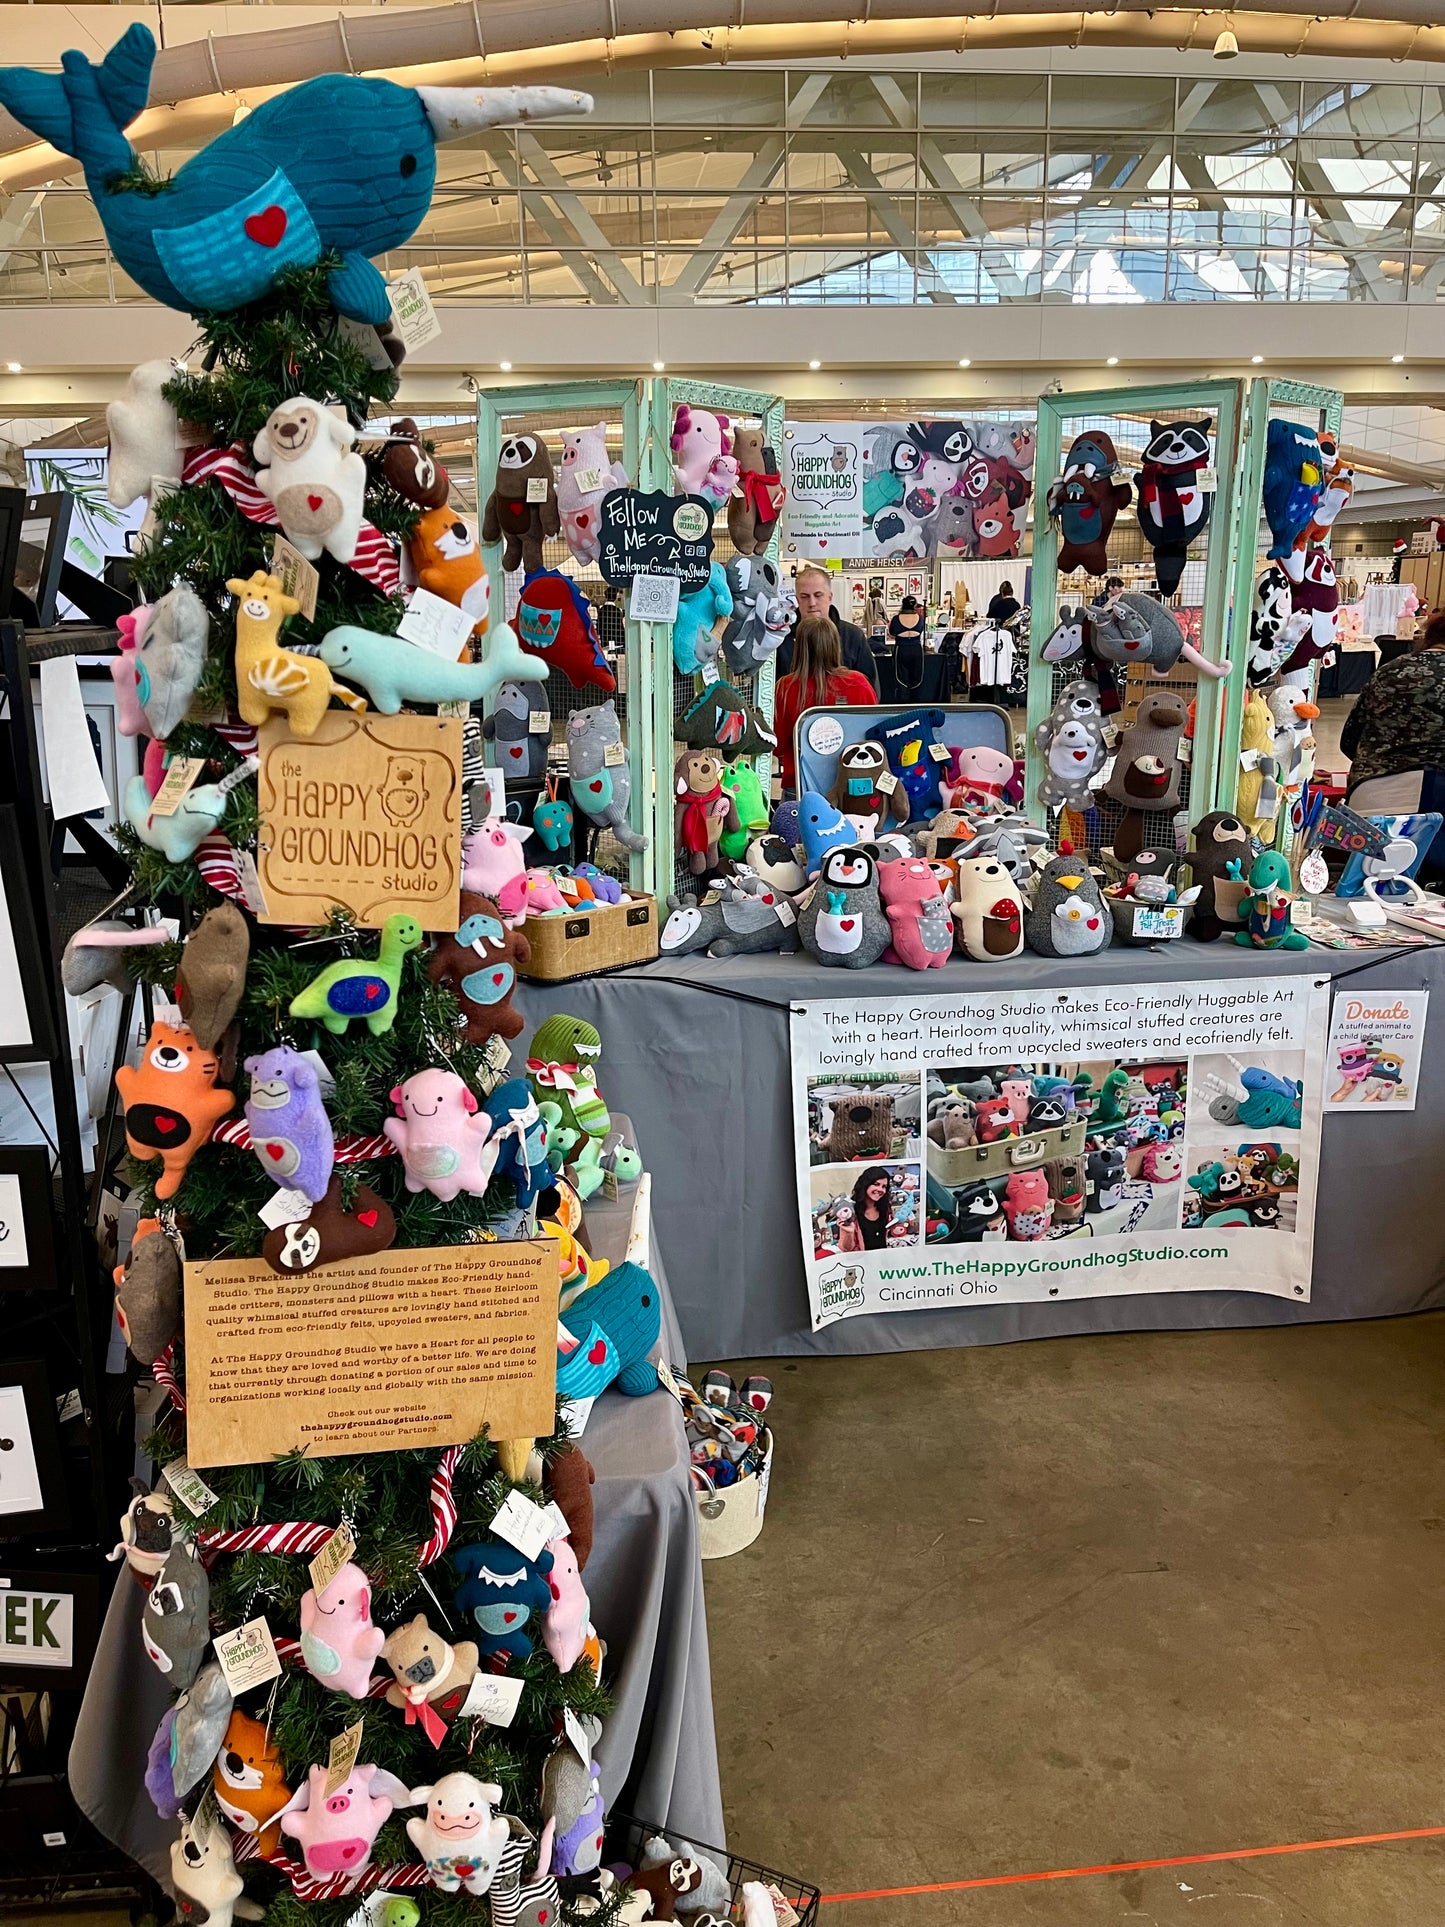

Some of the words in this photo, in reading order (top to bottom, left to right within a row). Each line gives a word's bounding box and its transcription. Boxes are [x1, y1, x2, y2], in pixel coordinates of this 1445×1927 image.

[606, 496, 660, 527] Follow
[849, 558, 875, 567] ANNIE
[878, 558, 906, 567] HEISEY
[281, 760, 301, 776] the
[1316, 818, 1366, 850] HELLO
[822, 1012, 849, 1025] The
[856, 1011, 904, 1025] Happy
[909, 1006, 994, 1021] Groundhog
[1000, 1004, 1046, 1016] Studio
[1051, 1002, 1098, 1014] makes
[1104, 994, 1192, 1011] Eco-Friendly
[1198, 990, 1268, 1006] Huggable
[1274, 990, 1293, 1001] Art
[1347, 1001, 1409, 1020] Donate
[832, 1030, 860, 1044] with
[882, 1028, 923, 1041] heart.
[930, 1024, 996, 1038] Heirloom
[1002, 1022, 1055, 1037] quality,
[1061, 1017, 1132, 1032] whimsical
[1138, 1014, 1184, 1028] stuffed
[1190, 1012, 1254, 1026] creatures
[1260, 1011, 1282, 1022] are
[819, 1051, 875, 1066] lovingly
[880, 1046, 917, 1061] hand
[923, 1044, 972, 1058] crafted
[978, 1042, 1011, 1055] from
[1018, 1038, 1080, 1056] upcycled
[1086, 1037, 1148, 1050] sweaters
[1153, 1034, 1180, 1047] and
[1186, 1028, 1262, 1045] ecofriendly
[1268, 1026, 1294, 1040] felt.
[205, 1277, 245, 1286] Melissa
[326, 1269, 355, 1278] artist
[358, 1268, 376, 1276] and
[380, 1266, 418, 1275] founder
[455, 1262, 486, 1270] Happy
[489, 1258, 542, 1268] Groundhog
[879, 1246, 1229, 1280] www.TheHappyGroundhogStudio.com
[208, 1304, 236, 1312] made
[240, 1300, 283, 1310] critters,
[286, 1298, 334, 1306] monsters
[337, 1296, 356, 1304] and
[358, 1294, 394, 1304] pillows
[398, 1290, 419, 1300] with
[463, 1286, 492, 1295] These
[494, 1282, 538, 1292] Heirloom
[254, 1287, 274, 1296] The
[277, 1286, 310, 1296] Happy
[313, 1282, 369, 1292] Groundhog
[372, 1280, 404, 1288] Studio
[407, 1277, 438, 1286] makes
[442, 1272, 504, 1284] Eco-Friendly
[879, 1284, 954, 1301] Cincinnati
[960, 1282, 998, 1296] Ohio
[206, 1316, 243, 1326] quality
[247, 1312, 298, 1322] whimsical
[302, 1309, 337, 1318] stuffed
[341, 1306, 388, 1316] creatures
[412, 1302, 450, 1312] lovingly
[454, 1299, 478, 1308] hand
[480, 1296, 520, 1306] stitched
[522, 1294, 540, 1303] and
[217, 1328, 254, 1338] crafted
[258, 1326, 282, 1335] from
[286, 1322, 347, 1332] eco-friendly
[378, 1317, 422, 1328] upcycled
[424, 1314, 471, 1323] sweaters,
[474, 1310, 492, 1319] and
[494, 1308, 530, 1318] fabrics.
[210, 1368, 238, 1377] know
[241, 1366, 262, 1375] that
[266, 1364, 288, 1374] they
[292, 1364, 308, 1372] are
[312, 1361, 338, 1370] loved
[342, 1359, 360, 1367] and
[363, 1356, 398, 1366] worthy
[422, 1352, 452, 1361] better
[492, 1348, 507, 1356] are
[510, 1346, 536, 1356] doing
[226, 1355, 246, 1363] The
[249, 1352, 282, 1362] Happy
[286, 1348, 342, 1358] Groundhog
[344, 1346, 376, 1354] Studio
[396, 1342, 418, 1350] have
[430, 1339, 458, 1348] Heart
[461, 1338, 474, 1346] for
[492, 1335, 522, 1344] people
[209, 1382, 231, 1390] that
[234, 1378, 284, 1388] currently
[286, 1374, 326, 1385] through
[330, 1370, 374, 1381] donating
[386, 1368, 422, 1378] portion
[456, 1363, 480, 1372] sales
[483, 1360, 500, 1369] and
[504, 1359, 524, 1368] time
[210, 1392, 280, 1404] organizations
[284, 1388, 326, 1397] working
[328, 1384, 362, 1394] locally
[364, 1383, 382, 1391] and
[386, 1380, 424, 1390] globally
[427, 1378, 448, 1386] with
[451, 1376, 466, 1384] the
[470, 1374, 494, 1382] same
[497, 1371, 536, 1381] mission.
[300, 1413, 452, 1432] thehappygroundhogstudio.com
[328, 1409, 354, 1418] Check
[358, 1408, 372, 1416] out
[394, 1404, 426, 1412] website
[326, 1432, 350, 1441] learn
[352, 1431, 378, 1439] about
[0, 1596, 61, 1648] EK
